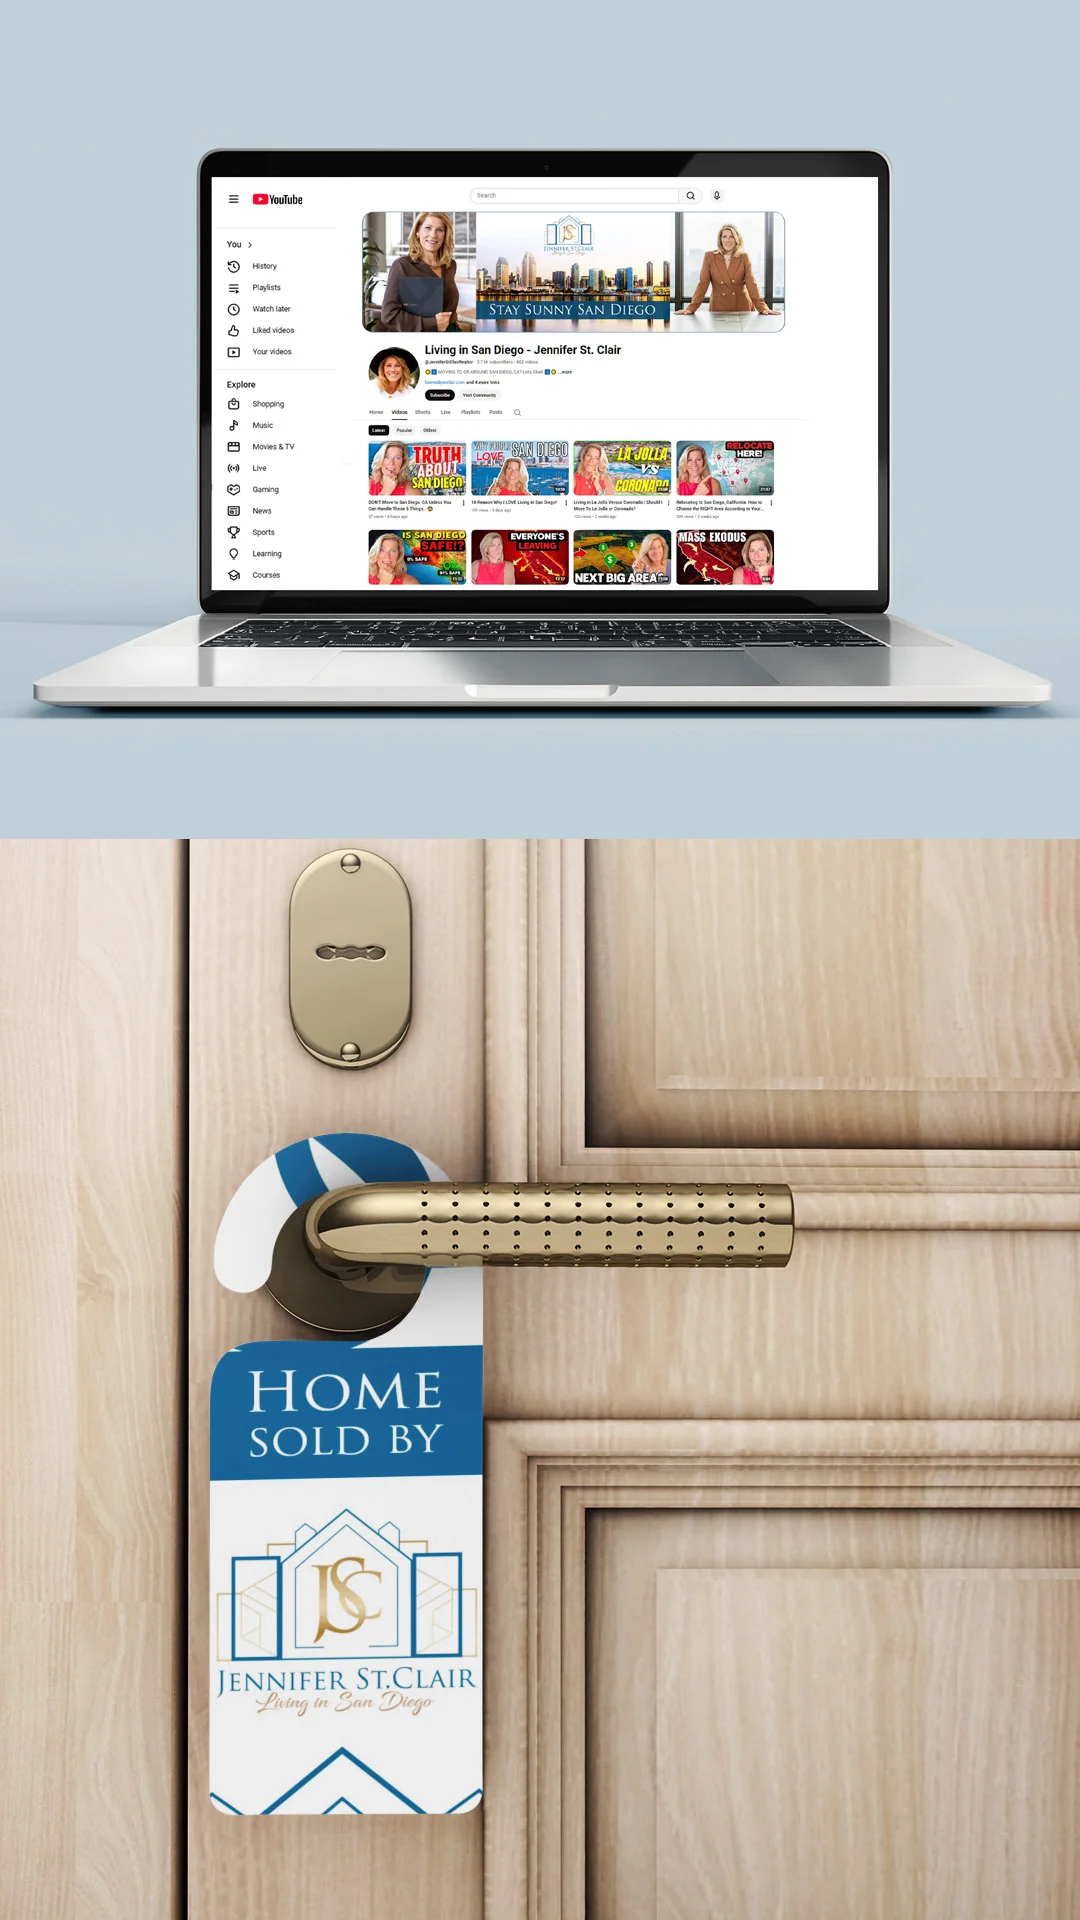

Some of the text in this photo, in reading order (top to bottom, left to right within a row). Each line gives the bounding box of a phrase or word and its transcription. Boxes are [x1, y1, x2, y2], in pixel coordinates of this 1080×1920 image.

[269, 194, 303, 205] YouTube
[227, 241, 242, 249] You
[252, 262, 277, 271] History
[252, 284, 281, 293] Playlists
[252, 305, 291, 313] Watch later
[252, 326, 295, 335] Liked videos
[252, 348, 292, 356] Your videos
[425, 345, 621, 357] Living in San Diego Jennifer St. Clair
[227, 381, 256, 390] Explore
[252, 401, 284, 409] Shopping
[512, 442, 568, 457] SAN DIEGO
[617, 447, 668, 461] LA JOLLA
[413, 446, 462, 464] TRUTH
[476, 452, 504, 461] LOVE
[417, 460, 459, 478] ABOUT
[412, 477, 431, 489] SAN
[433, 477, 463, 489] DIEGO
[252, 486, 279, 494] Gaming
[252, 529, 275, 537] Sports
[510, 532, 565, 540] EVERYONE'S
[680, 532, 747, 542] MASS EXODUS
[421, 541, 465, 551] SAFE!?
[252, 550, 282, 559] Learning
[252, 571, 281, 579] Courses
[575, 573, 604, 583] NEXT
[606, 573, 625, 583] BIG
[249, 1423, 444, 1458] SOLD BY
[255, 1691, 434, 1717] Living in San Diego
